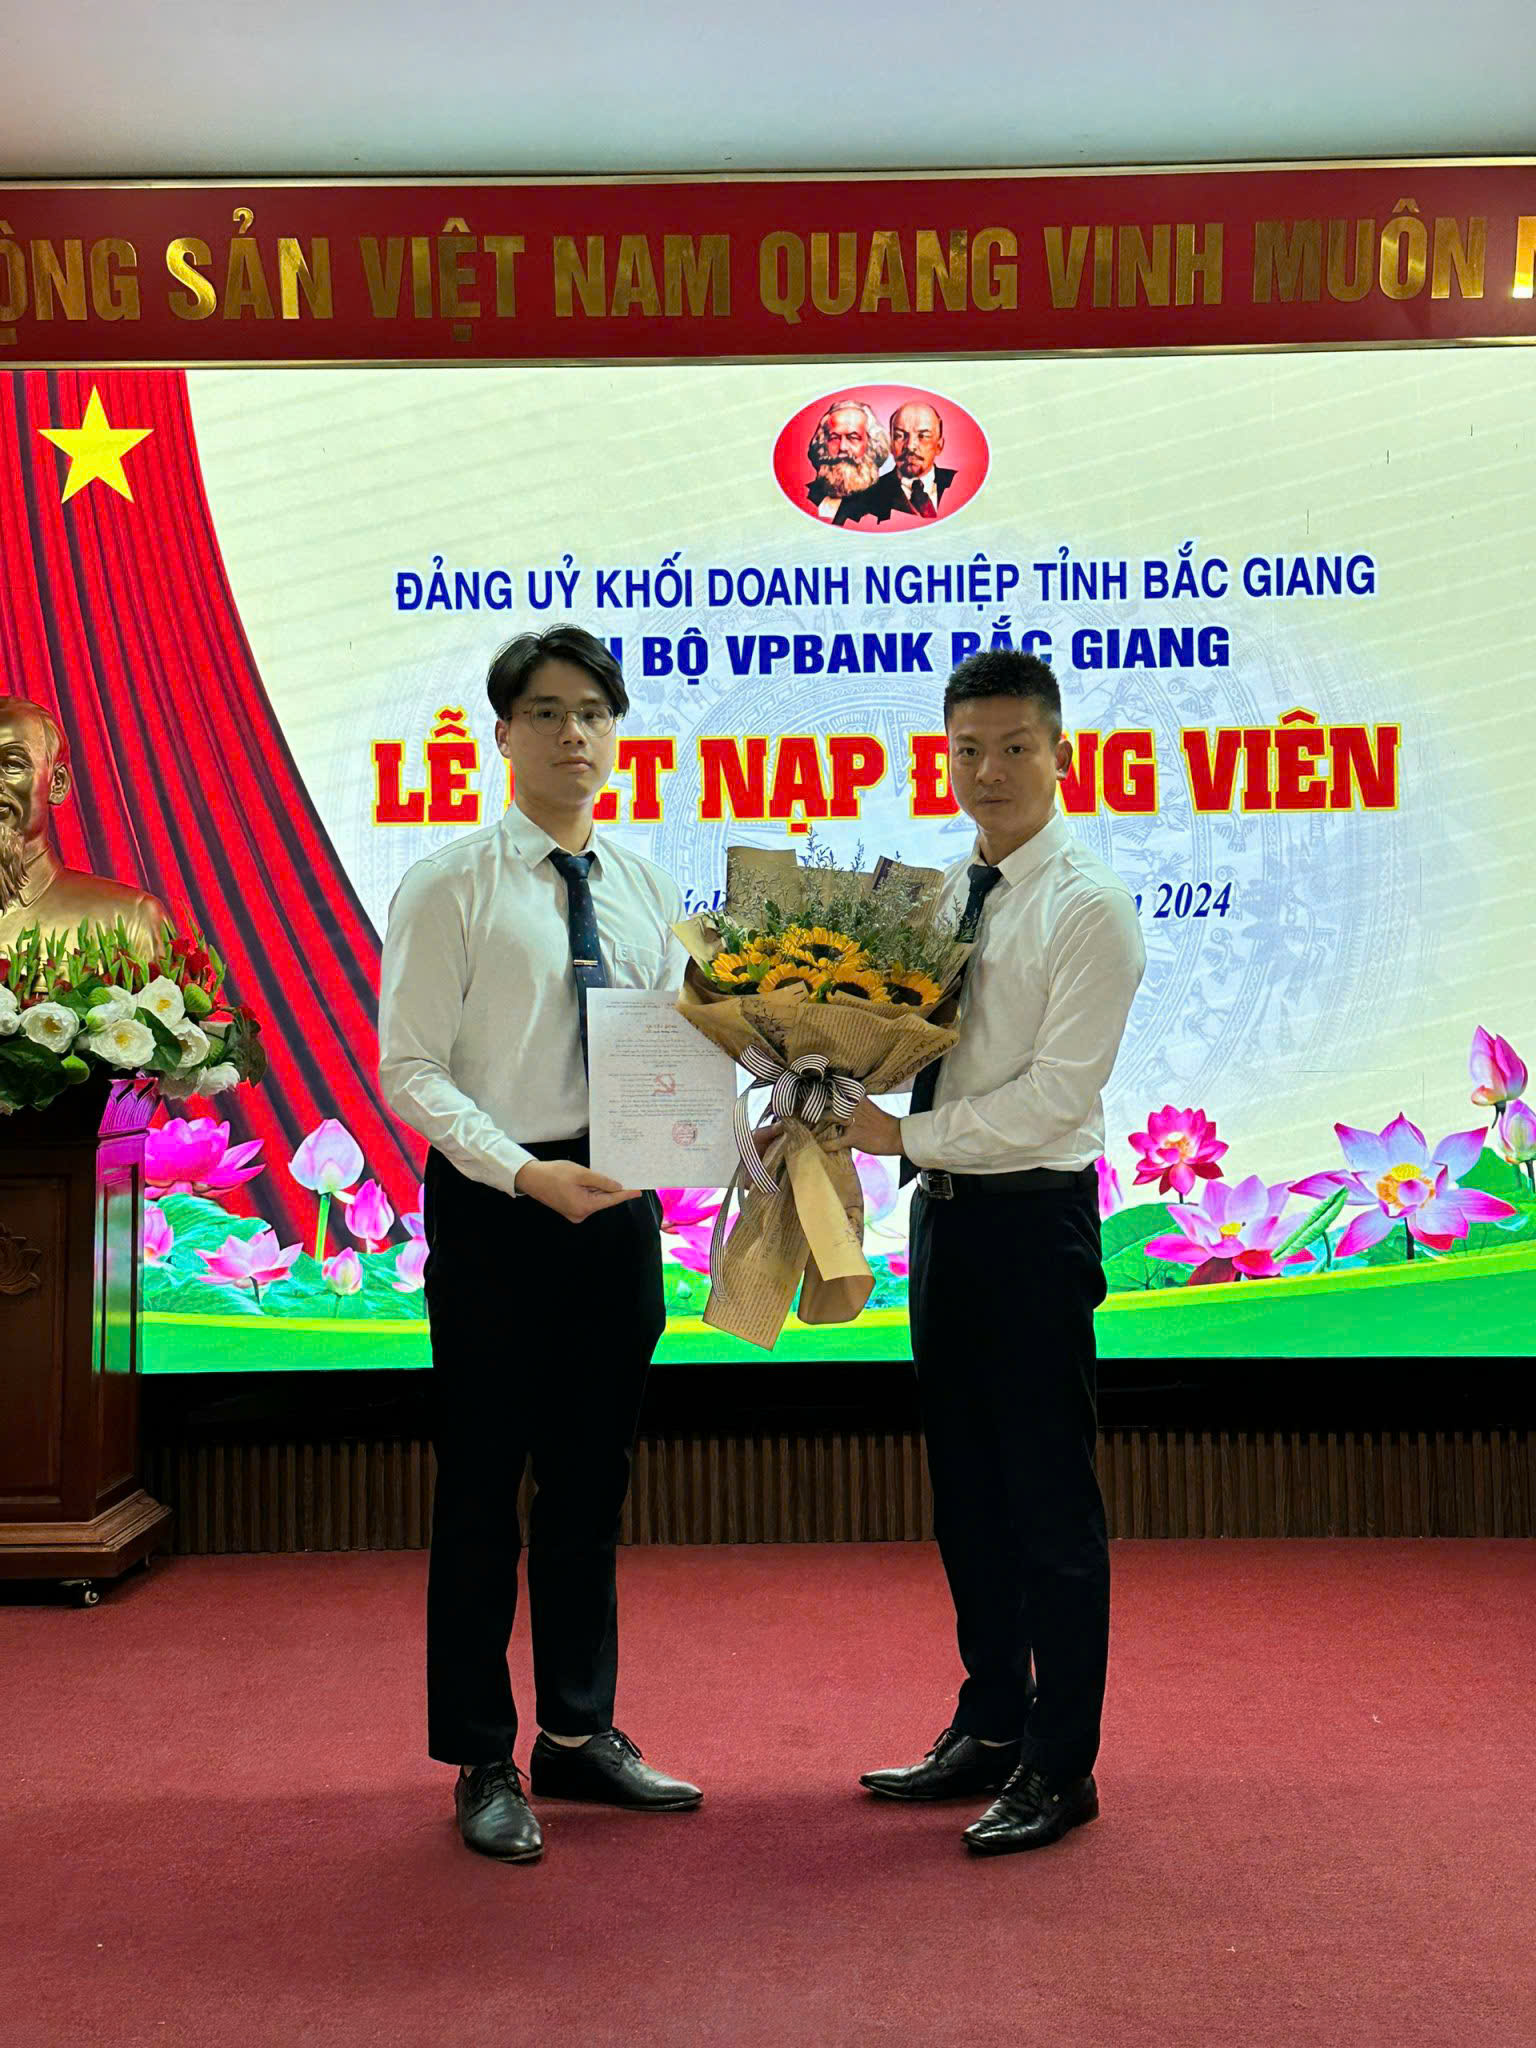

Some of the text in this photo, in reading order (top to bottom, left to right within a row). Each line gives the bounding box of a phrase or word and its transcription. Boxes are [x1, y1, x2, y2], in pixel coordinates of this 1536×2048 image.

[165, 206, 333, 321] SẢN
[361, 216, 526, 342] VIỆT
[552, 233, 731, 318] NAM
[758, 227, 1020, 325] QUANG
[1043, 223, 1224, 307] VINH
[1253, 198, 1487, 303] MUÔN
[396, 541, 1375, 611] ĐẢNG UỶ KHỐI DOANH NGHIỆP TỈNH BẮC GIANG
[642, 627, 709, 686] BỘ
[725, 632, 934, 676] VPBANK
[1071, 626, 1229, 670] GIANG
[373, 708, 479, 824] LỄ
[699, 736, 885, 834] NẠP
[910, 731, 1157, 817] ĐNG
[1182, 709, 1399, 812] VIÊN
[1153, 881, 1232, 919] 2024
